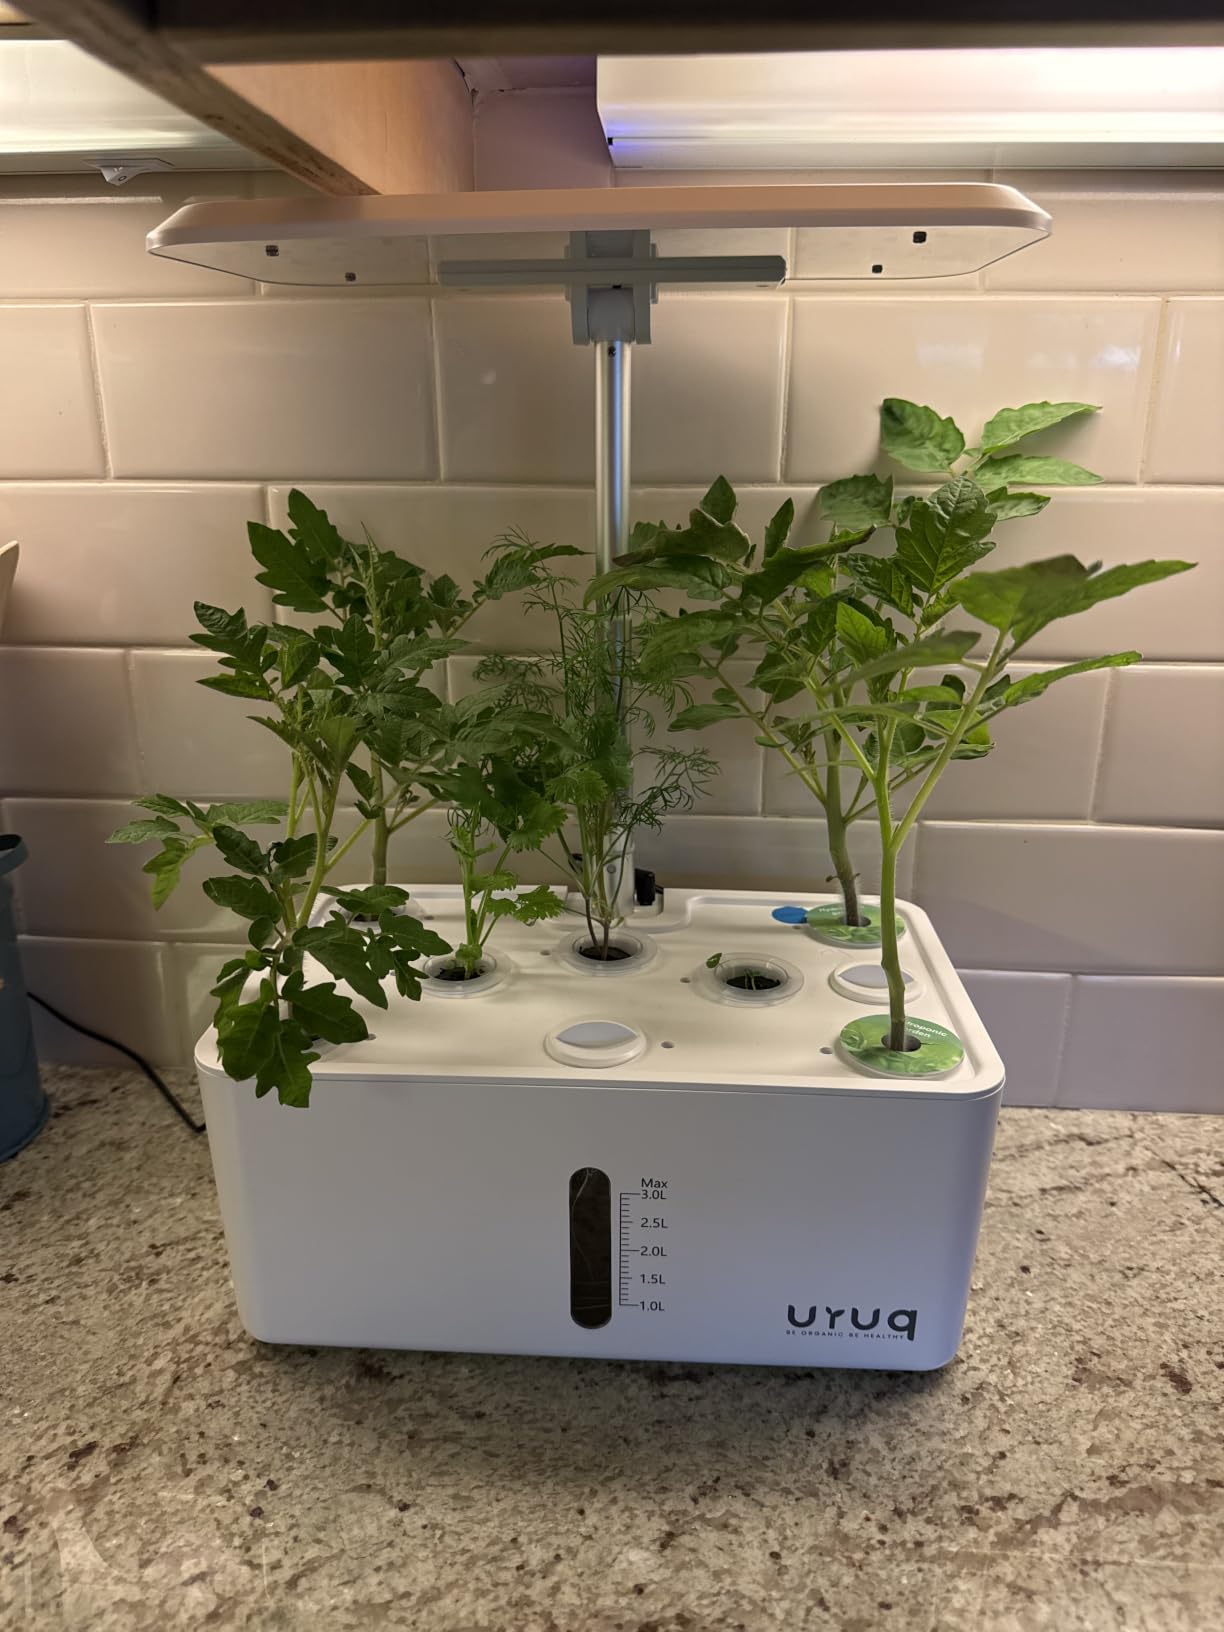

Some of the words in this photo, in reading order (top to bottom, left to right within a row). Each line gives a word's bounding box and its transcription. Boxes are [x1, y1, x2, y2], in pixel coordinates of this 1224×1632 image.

[906, 1021, 948, 1037] roponic
[641, 1178, 668, 1188] Max
[641, 1189, 667, 1199] 3.0L
[640, 1218, 668, 1229] 2.5L
[640, 1246, 667, 1256] 2.0L
[640, 1274, 666, 1284] 1.5L
[639, 1301, 665, 1311] 1.0L
